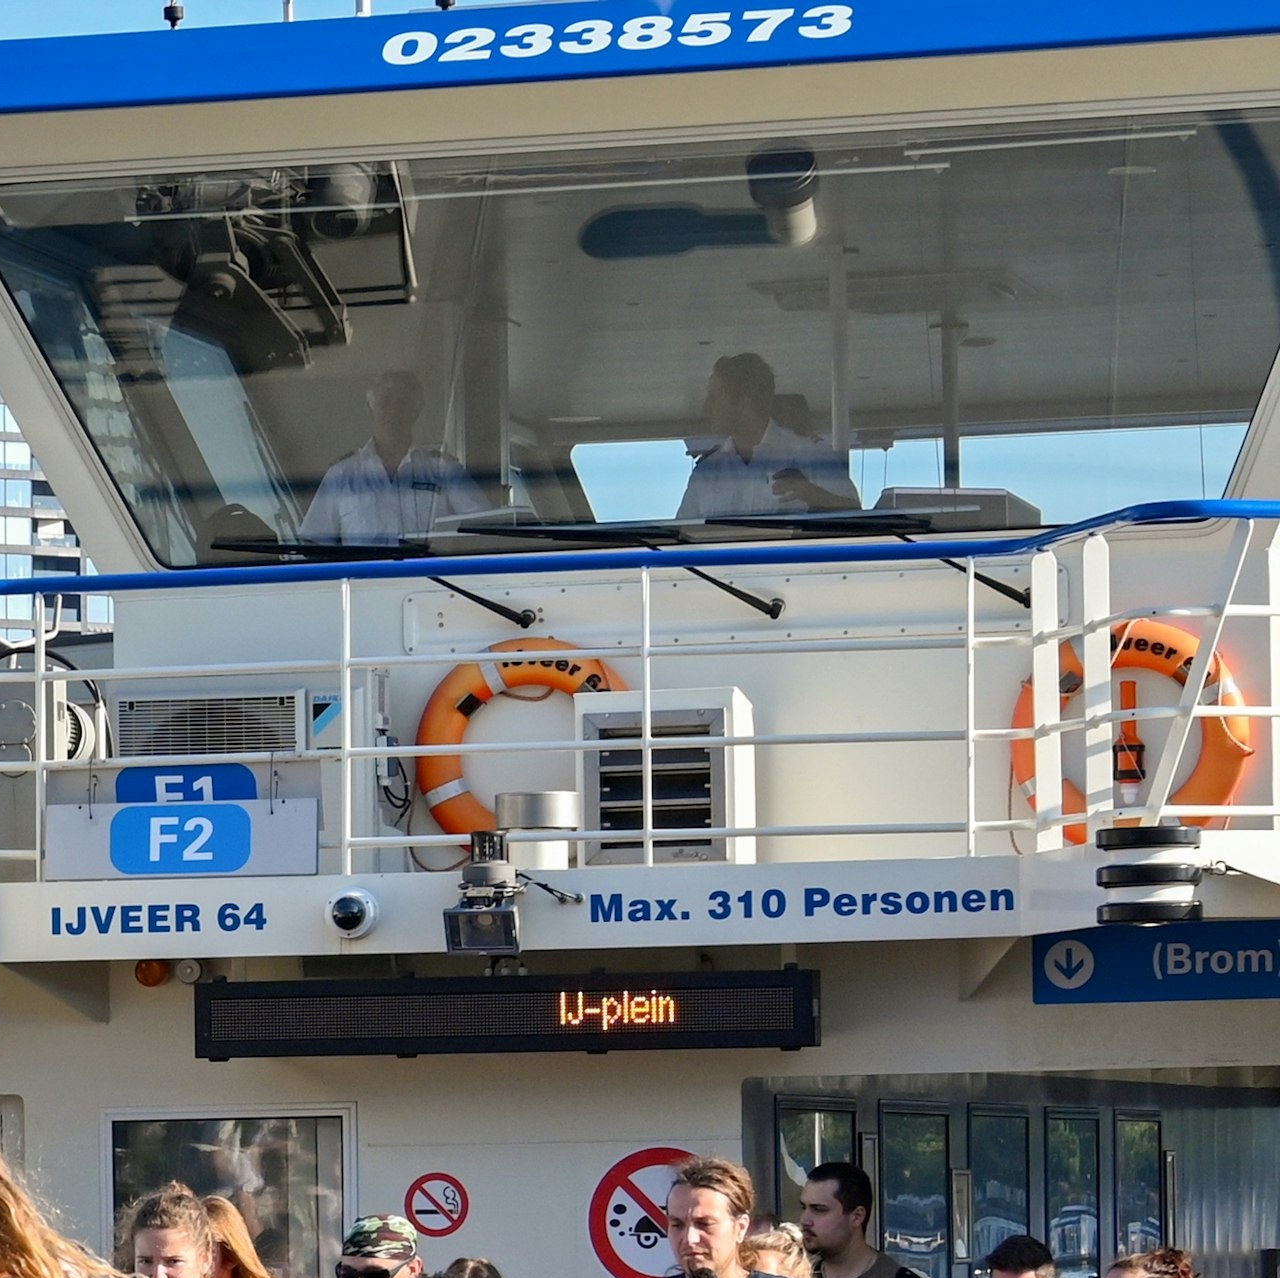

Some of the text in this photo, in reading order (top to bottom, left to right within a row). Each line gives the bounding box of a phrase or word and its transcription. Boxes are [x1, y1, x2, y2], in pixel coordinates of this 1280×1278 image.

[381, 4, 854, 66] 02338573
[148, 816, 214, 862] F2
[51, 902, 268, 936] IJVEER 64
[589, 887, 1016, 924] Max. 310 Personen
[559, 989, 677, 1032] IJ-plein
